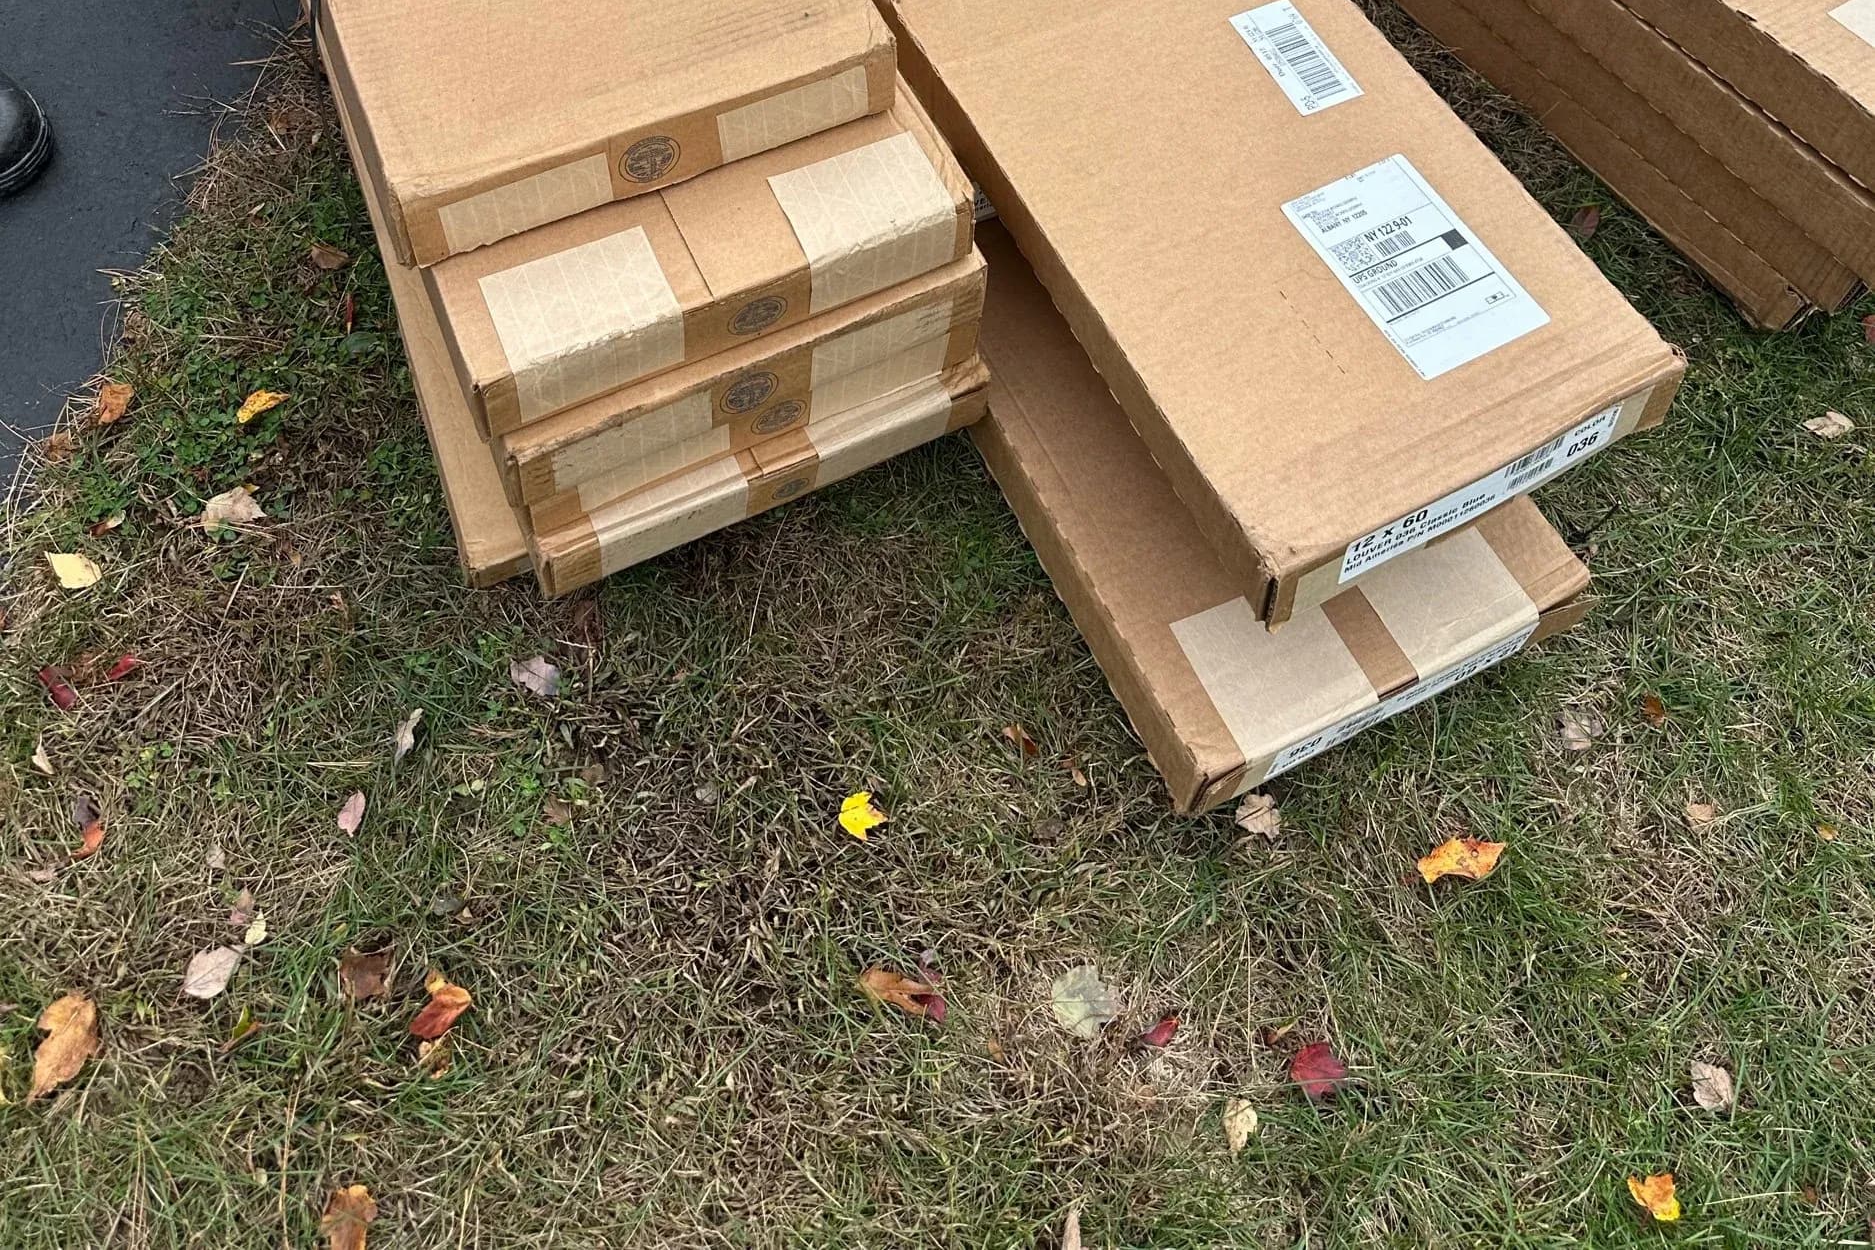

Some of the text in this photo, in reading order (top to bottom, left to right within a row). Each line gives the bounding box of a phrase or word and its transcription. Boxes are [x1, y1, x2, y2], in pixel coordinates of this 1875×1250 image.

[1321, 220, 1342, 234] ALBANY
[1342, 216, 1351, 225] NY
[1364, 216, 1413, 242] NY 122 9-01
[1352, 272, 1368, 284] UPS
[1366, 259, 1398, 278] GROUND
[1574, 415, 1606, 437] COLOR
[1566, 431, 1600, 457] 036
[1346, 493, 1486, 565] LOUVER 036 Classic Blue
[1351, 509, 1428, 552] 12 x 60
[1344, 561, 1362, 574] Mid
[1364, 539, 1405, 563] America
